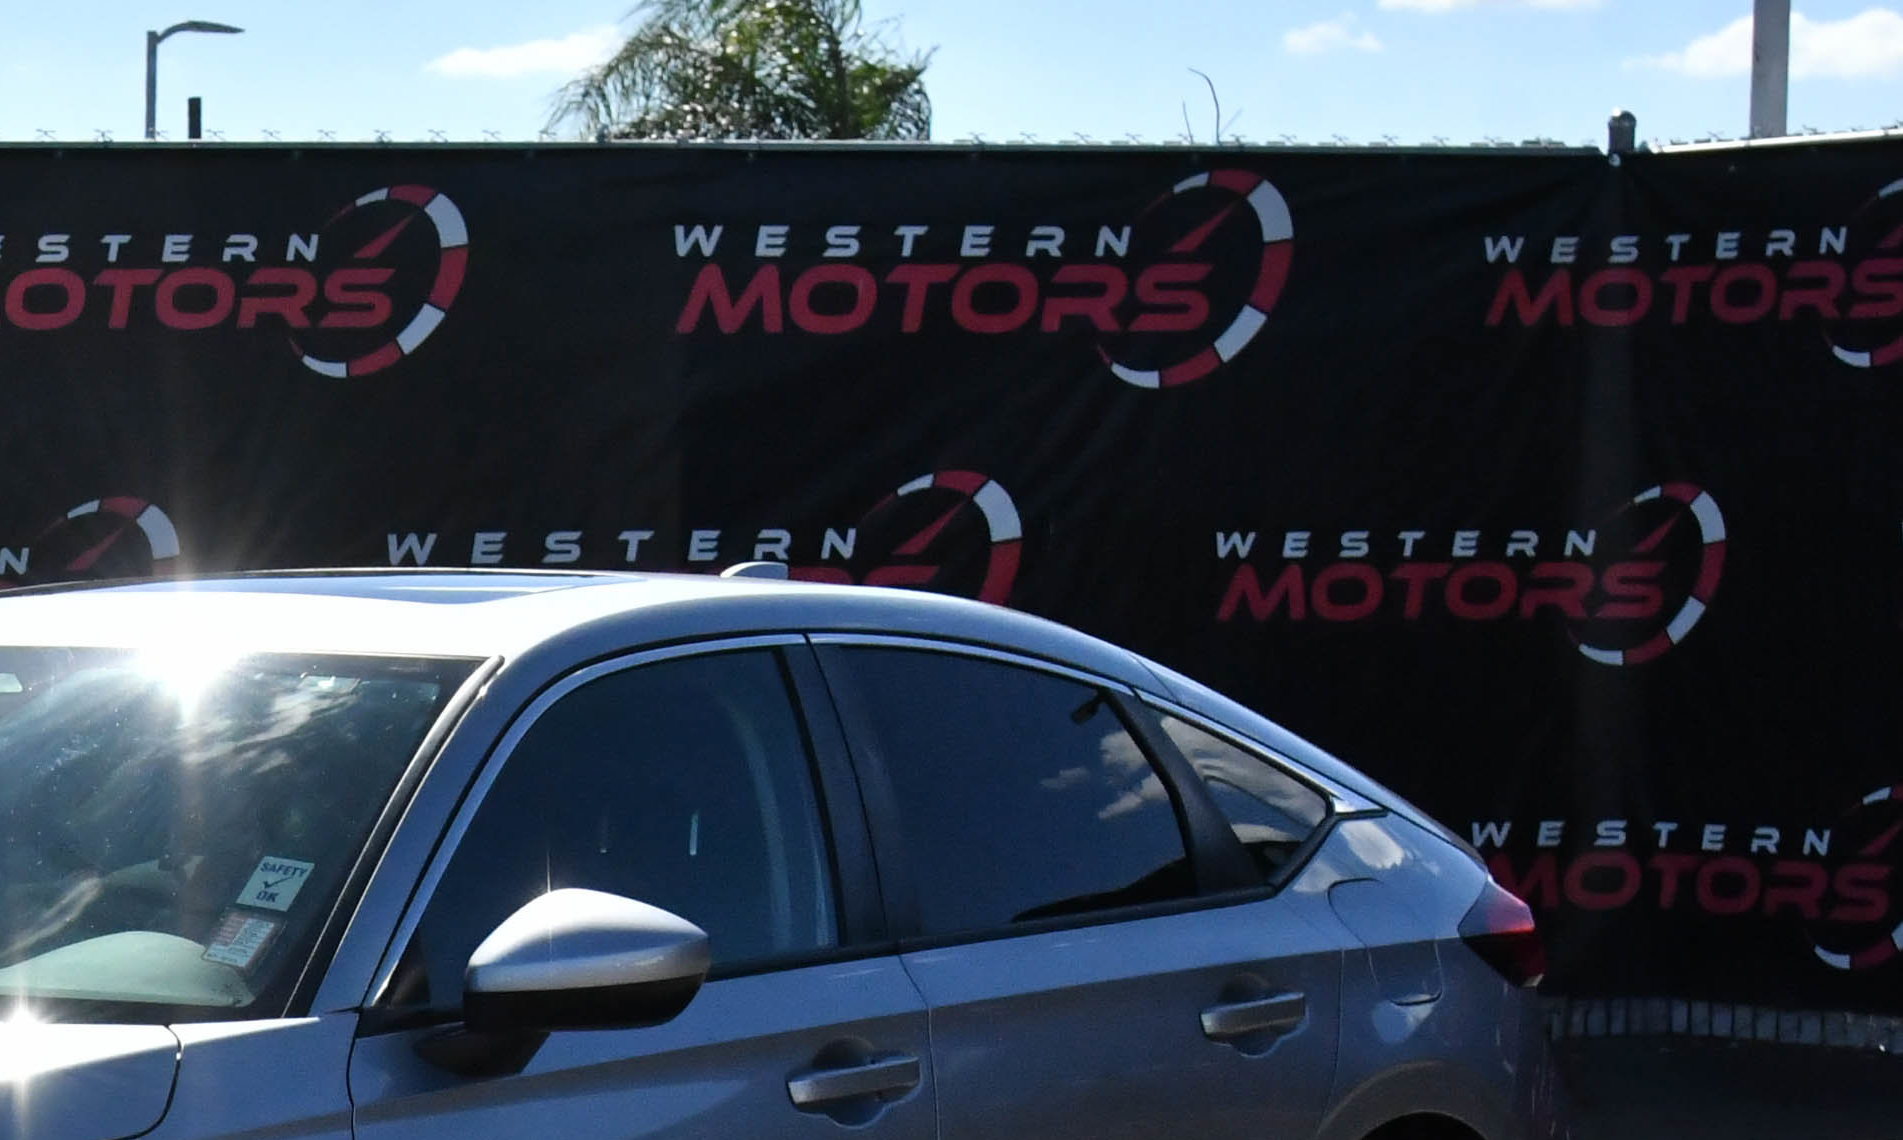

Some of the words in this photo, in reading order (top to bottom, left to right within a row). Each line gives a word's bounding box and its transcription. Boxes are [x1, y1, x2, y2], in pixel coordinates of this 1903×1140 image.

[674, 225, 1131, 258] WESTERN
[1484, 227, 1847, 263] WESTERN
[676, 262, 1212, 335] MOTORS
[1485, 257, 1903, 327] MOTORS
[387, 528, 857, 566] WESTERN
[1216, 529, 1597, 558] WESTERN
[1216, 559, 1665, 622] MOTORS
[1471, 820, 1831, 857] WESTERN
[261, 862, 307, 877] SAFETY
[1487, 850, 1894, 922] MOTORS
[256, 891, 278, 902] OK
